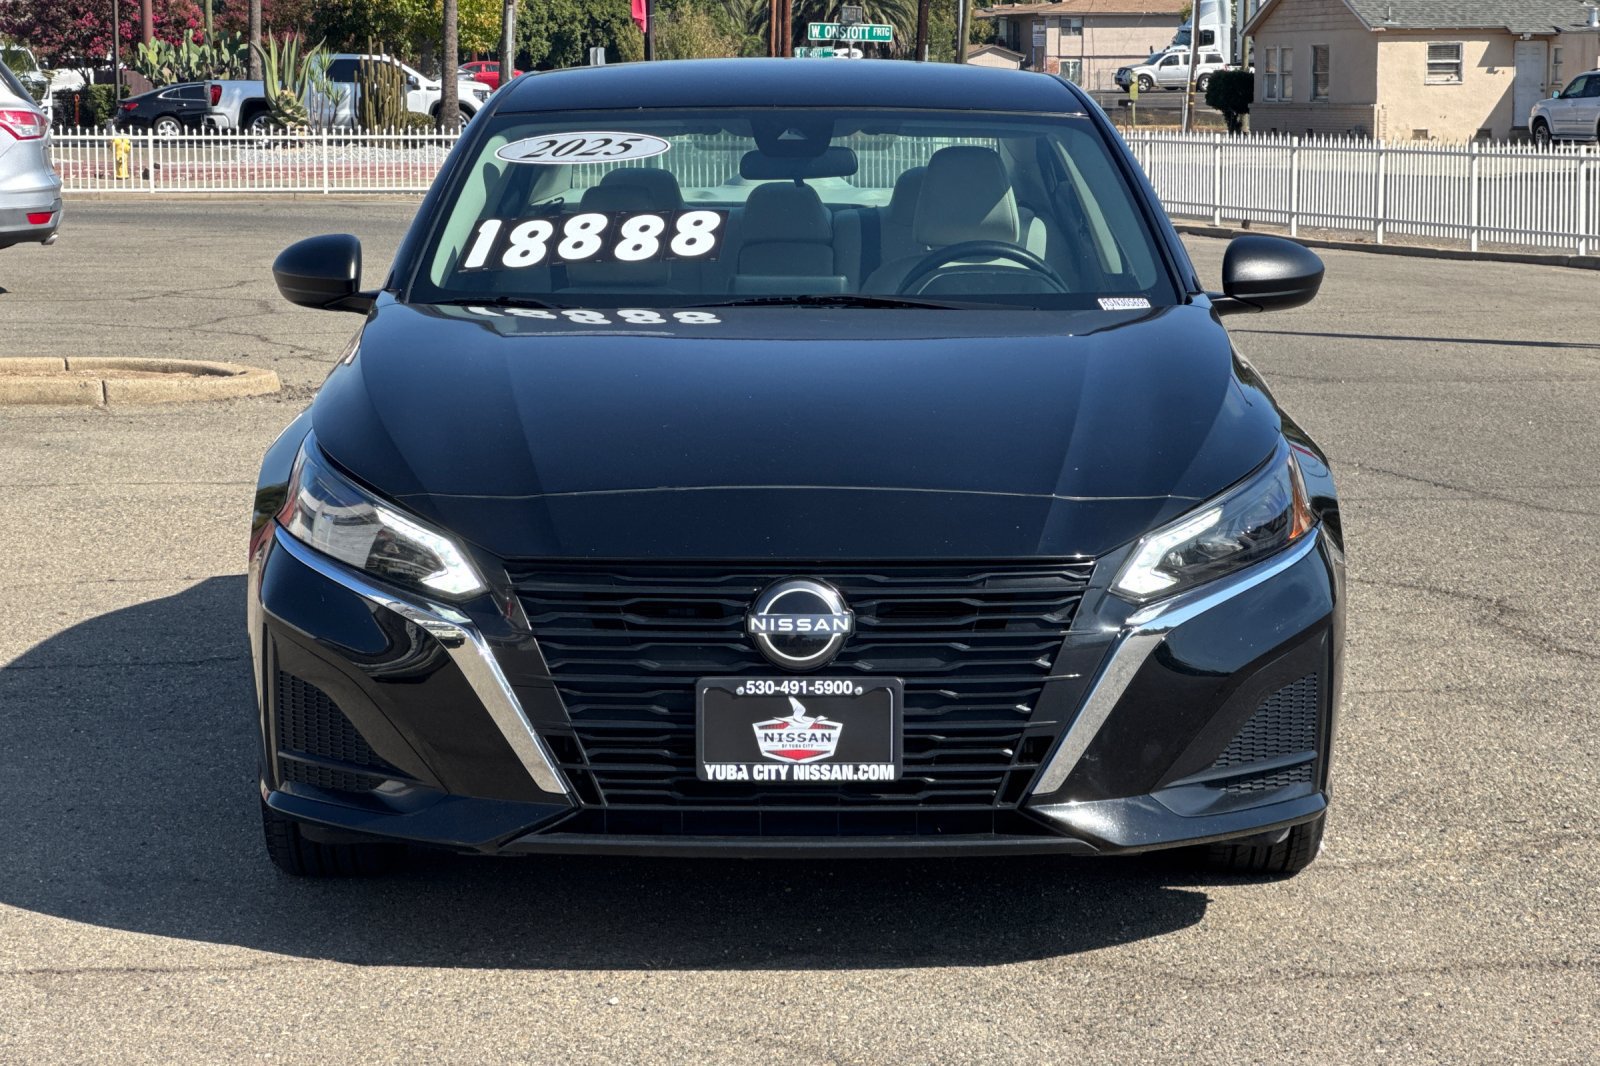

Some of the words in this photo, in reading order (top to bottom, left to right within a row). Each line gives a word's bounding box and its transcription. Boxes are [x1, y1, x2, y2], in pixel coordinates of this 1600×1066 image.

[825, 26, 871, 39] ONSTOTT
[873, 27, 890, 37] FRTG
[521, 138, 643, 158] 2025
[464, 210, 721, 268] 18888
[751, 618, 849, 631] NISSAN
[746, 681, 853, 695] 530-491-5900
[763, 733, 832, 743] NISSAN
[705, 765, 749, 780] YUBA
[753, 764, 789, 780] CITY
[793, 764, 895, 780] NISSAN.COM
